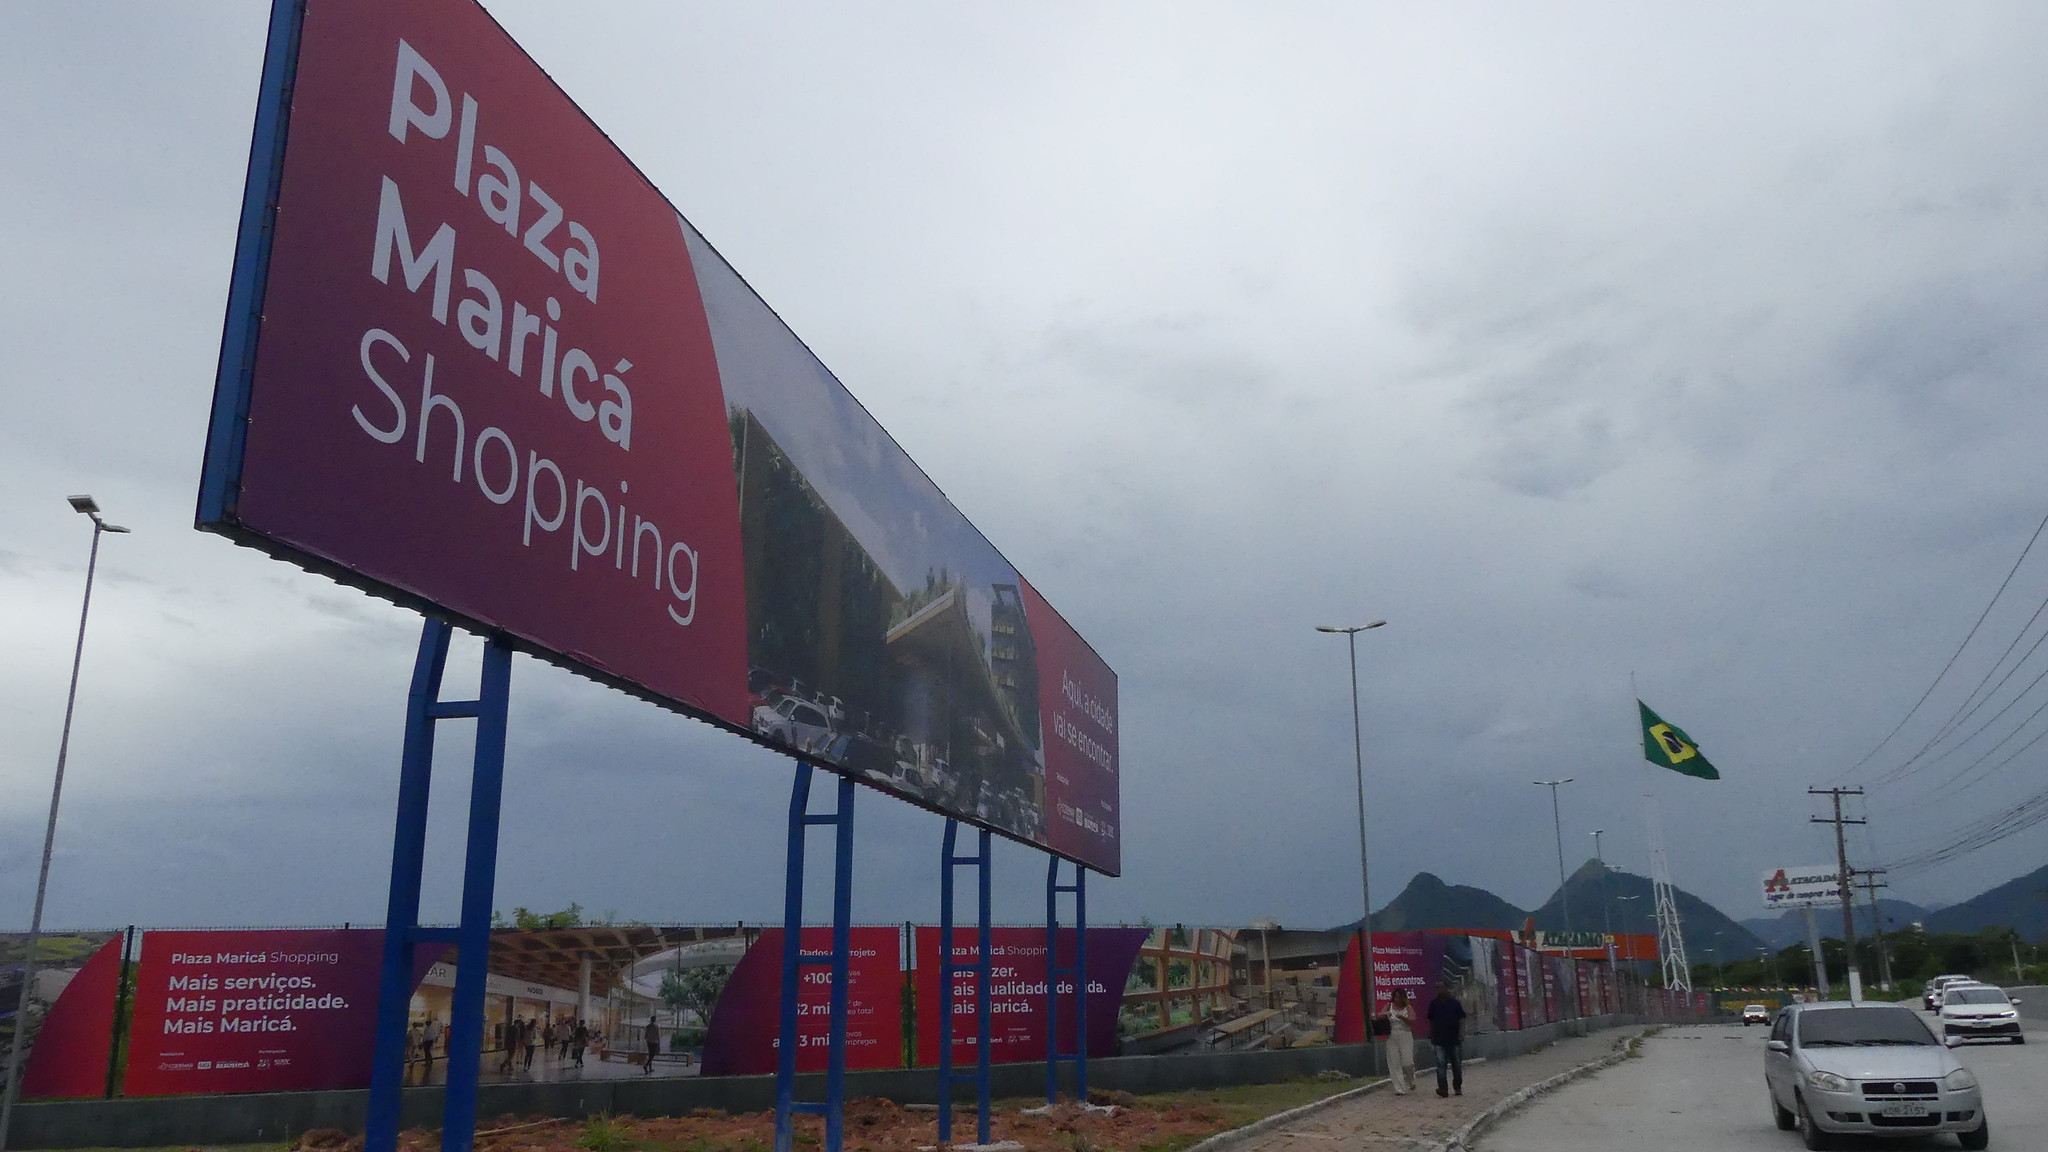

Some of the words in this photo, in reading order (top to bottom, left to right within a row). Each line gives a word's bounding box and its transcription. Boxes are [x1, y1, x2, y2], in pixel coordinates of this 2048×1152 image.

[388, 37, 600, 304] Plaza
[372, 175, 633, 451] Maricá
[351, 328, 698, 626] Shopping
[1063, 669, 1083, 714] Aqui,
[1090, 695, 1113, 734] cidade
[1053, 710, 1066, 739] vai
[1067, 722, 1077, 747] se
[848, 948, 877, 958] rojeto
[970, 945, 1005, 955] Micá
[1007, 945, 1048, 957] Shoppin
[171, 952, 212, 964] Plaza
[216, 951, 266, 964] Maricá
[270, 951, 339, 966] Shopping
[991, 966, 1018, 978] zer.
[1373, 961, 1390, 972] Mais
[1390, 962, 1410, 974] perto.
[168, 974, 219, 991] Mais
[224, 972, 317, 994] serviços.
[1375, 975, 1391, 986] Mais
[1391, 976, 1426, 986] encontros.
[953, 982, 975, 995] ais
[990, 981, 1048, 995] ualidad
[1056, 981, 1073, 994] de
[1376, 989, 1392, 1000] Mais
[166, 995, 216, 1013] Mais
[221, 993, 349, 1015] praticidade.
[812, 1002, 831, 1015] mi
[857, 1007, 874, 1015] total
[951, 1000, 975, 1014] ais
[990, 999, 1033, 1013] aricá.
[163, 1018, 214, 1035] Mais
[219, 1015, 297, 1034] Maricá.
[811, 1033, 830, 1046] mi
[845, 1038, 877, 1047] mpregos
